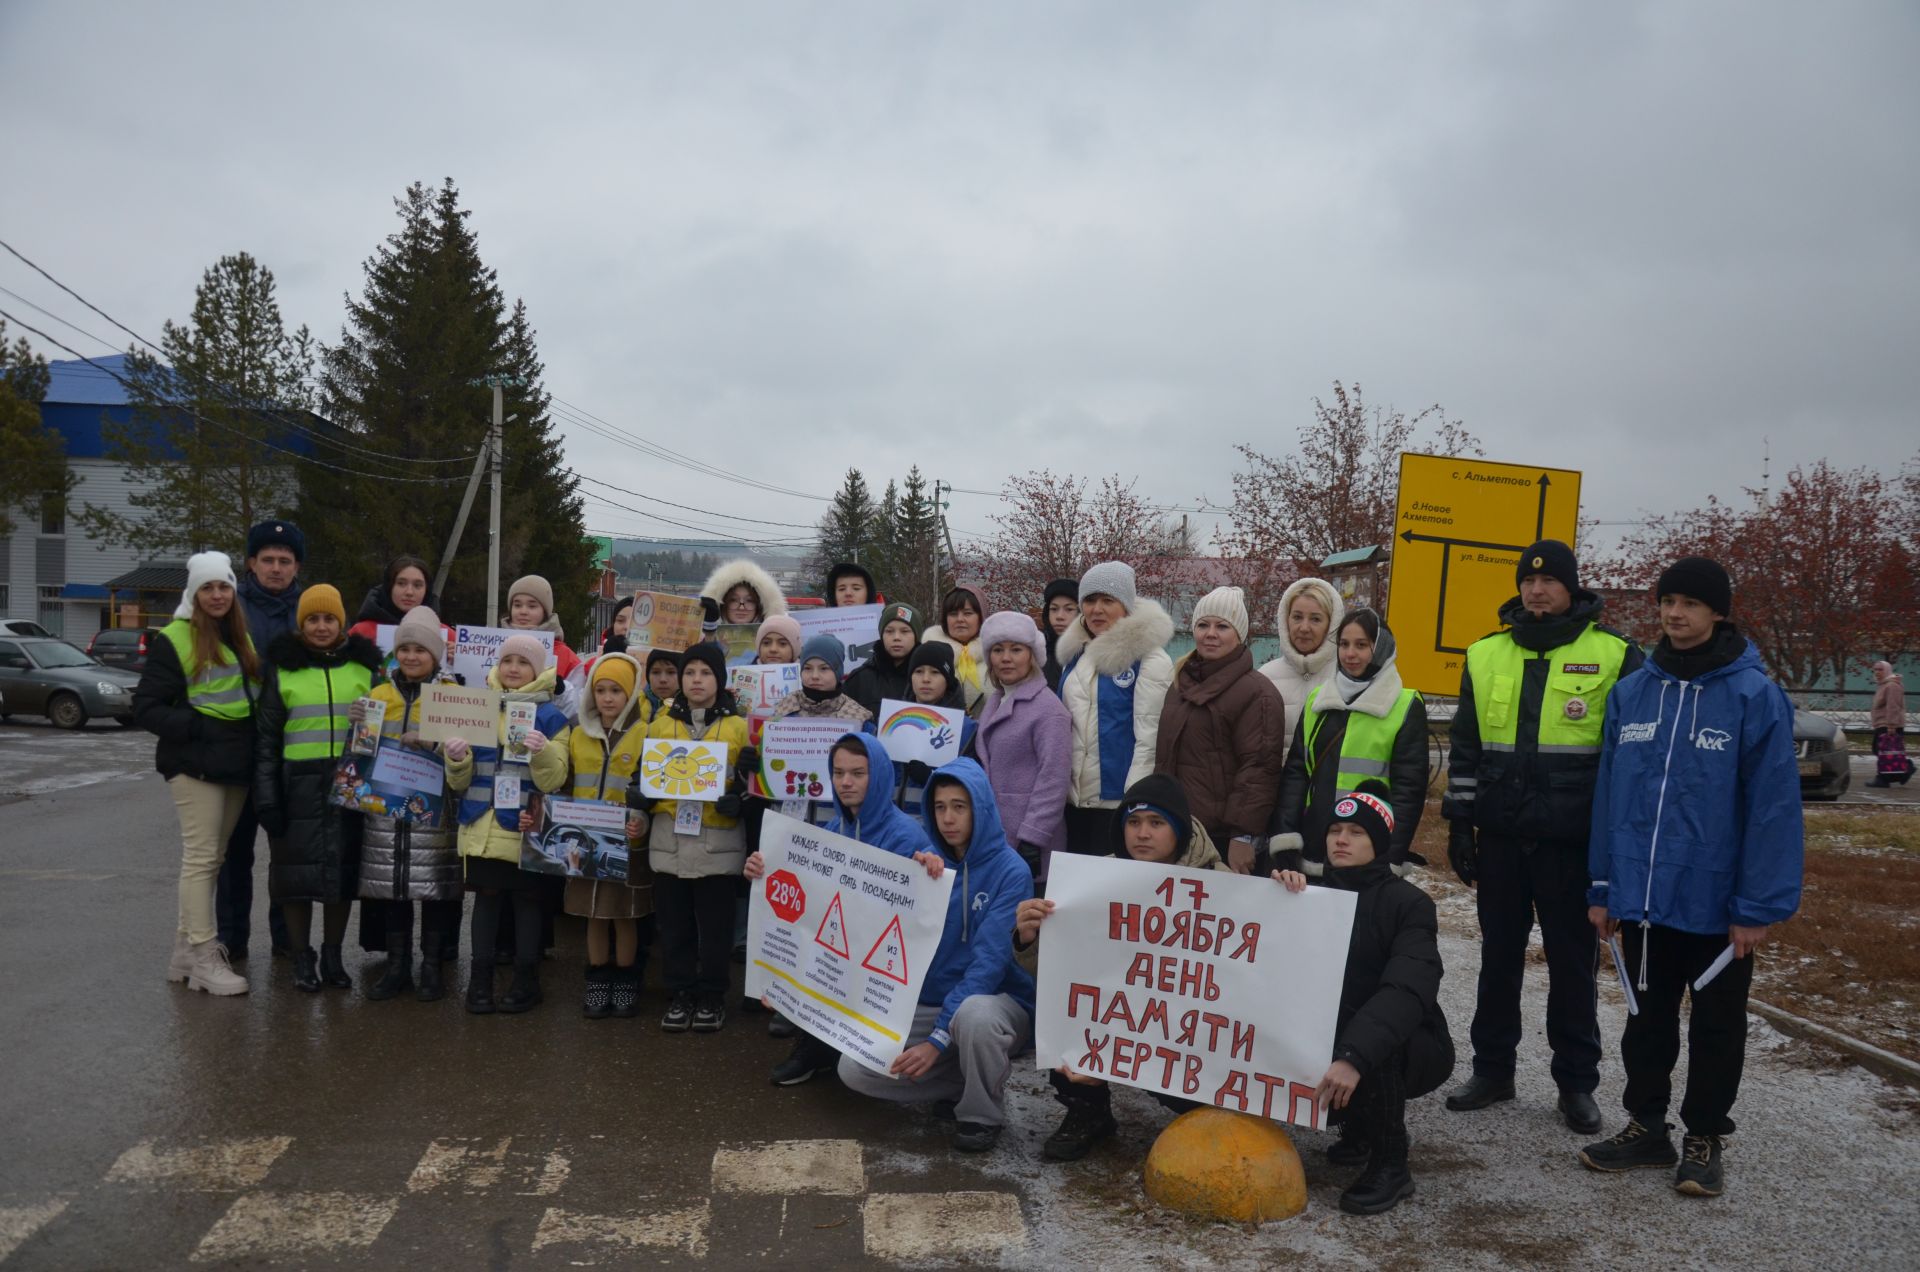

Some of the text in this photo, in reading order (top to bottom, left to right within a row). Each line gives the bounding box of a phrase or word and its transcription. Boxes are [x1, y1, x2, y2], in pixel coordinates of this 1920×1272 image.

[1464, 470, 1532, 488] Альметово
[1402, 512, 1454, 526] Ахметово
[1460, 554, 1474, 562] ул.
[428, 714, 490, 729] на переход
[849, 856, 898, 882] НАПИСАННОЕ
[898, 874, 910, 886] ЗА
[770, 879, 800, 912] 28%
[862, 881, 915, 910] ПОСЛЕДНИМ!
[1155, 877, 1210, 910] 17
[893, 926, 898, 938] 1
[1108, 902, 1261, 963] НОЯБРЯ
[886, 960, 893, 971] 5
[1126, 952, 1220, 1001] ДЕНЬ
[1068, 982, 1254, 1062] ПАМЯТИ
[1078, 1028, 1318, 1130] ЖЕРТВ ДТП
